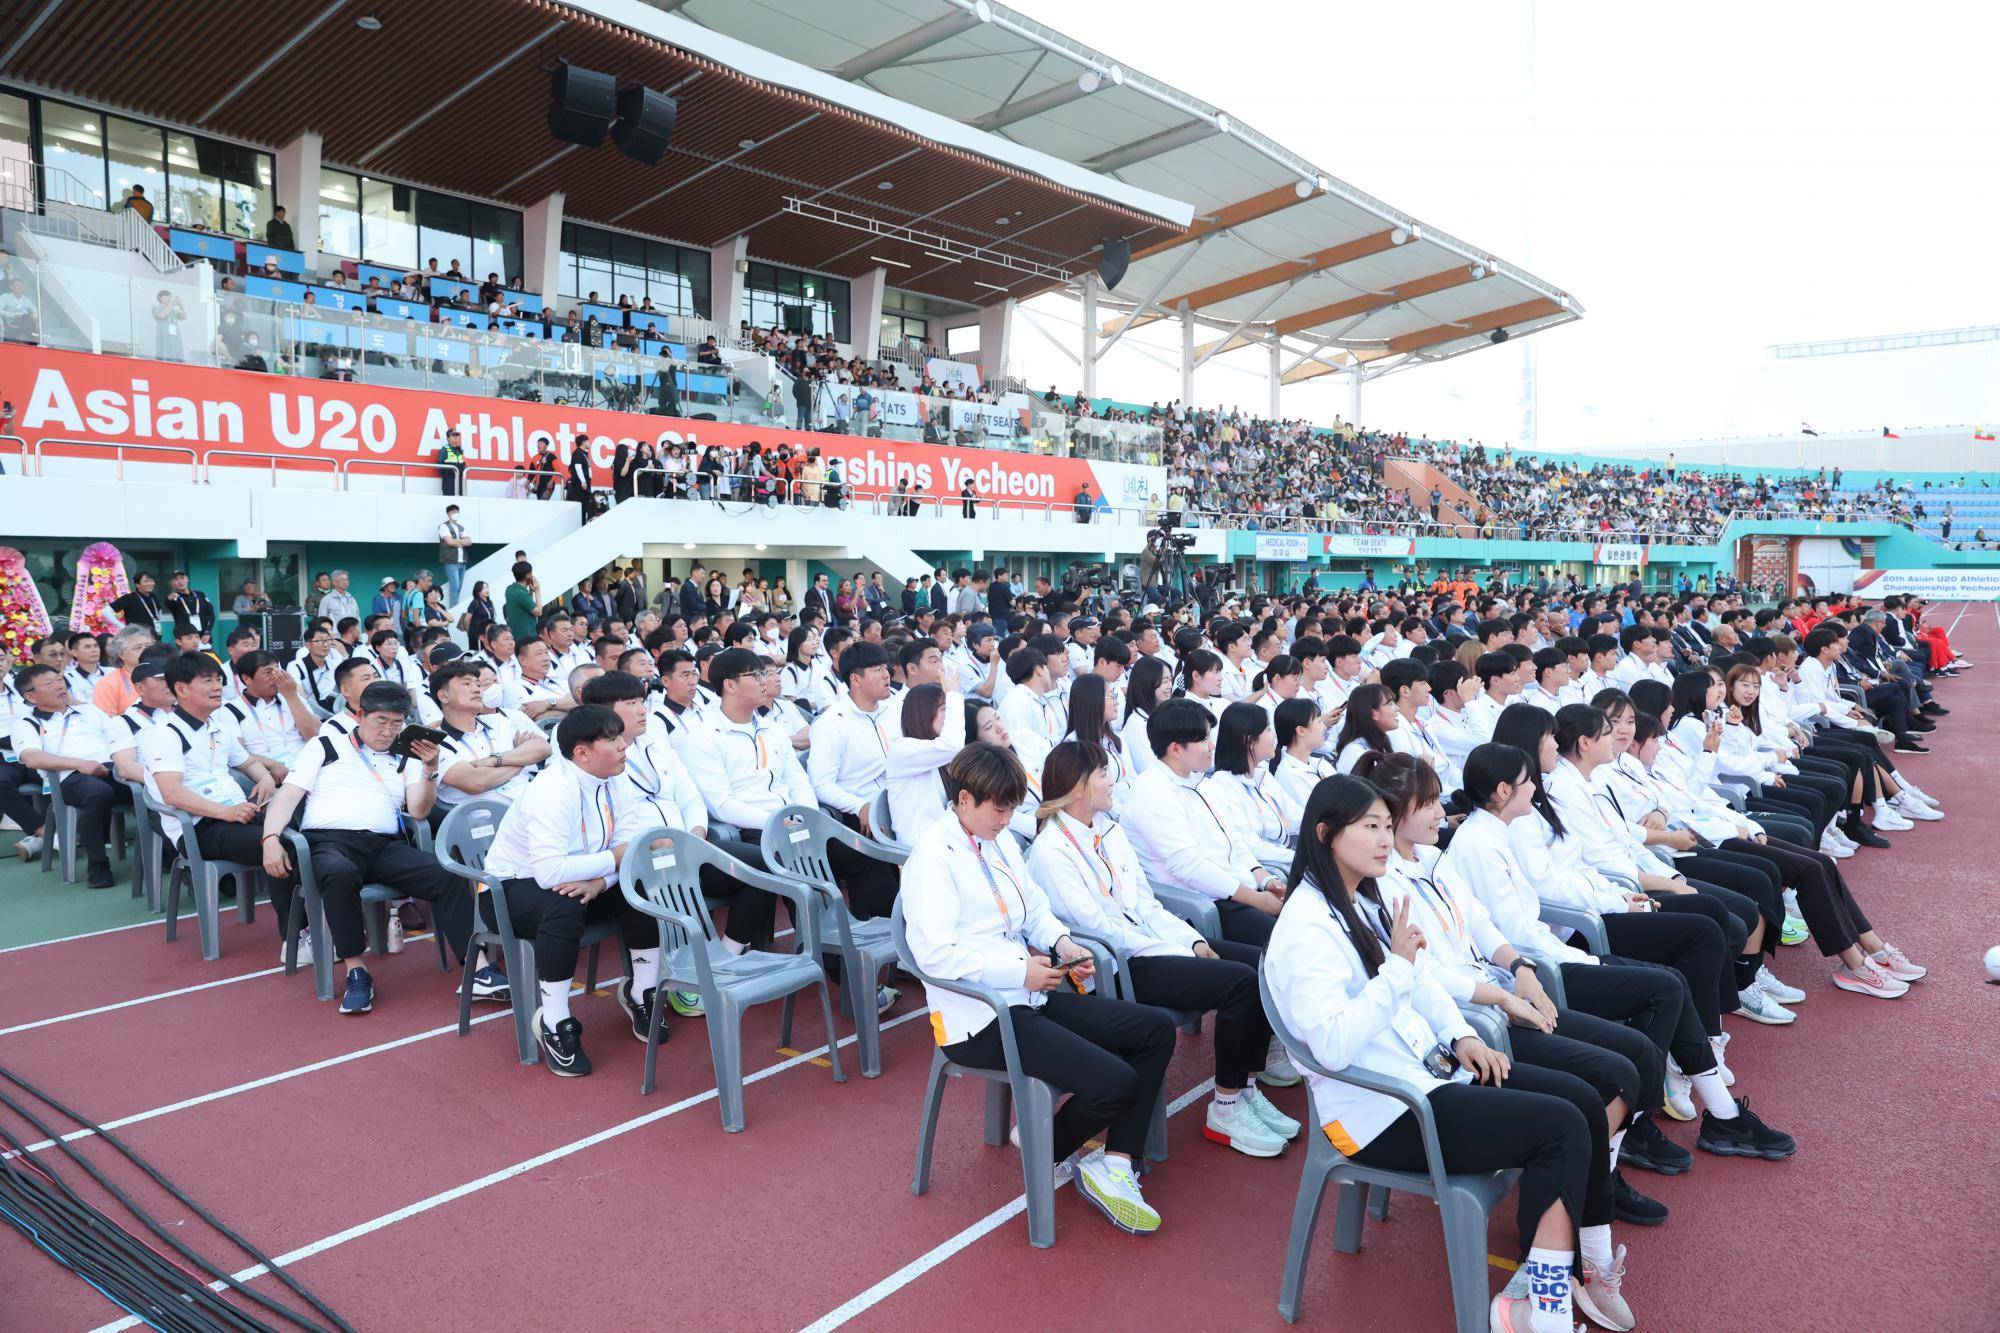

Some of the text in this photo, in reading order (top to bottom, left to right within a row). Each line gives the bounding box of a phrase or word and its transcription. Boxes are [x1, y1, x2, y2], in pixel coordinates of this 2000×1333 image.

[21, 368, 244, 443] Asian
[269, 392, 397, 454] U20
[941, 457, 1055, 498] Yecheon
[1266, 538, 1285, 547] MEDICAL
[1353, 538, 1369, 547] TEAM
[1882, 575, 1905, 583] 20th
[1908, 575, 1934, 583] Asian
[1937, 575, 1957, 583] U20
[1883, 584, 1957, 592] Championships
[1532, 1278, 1569, 1298] DO
